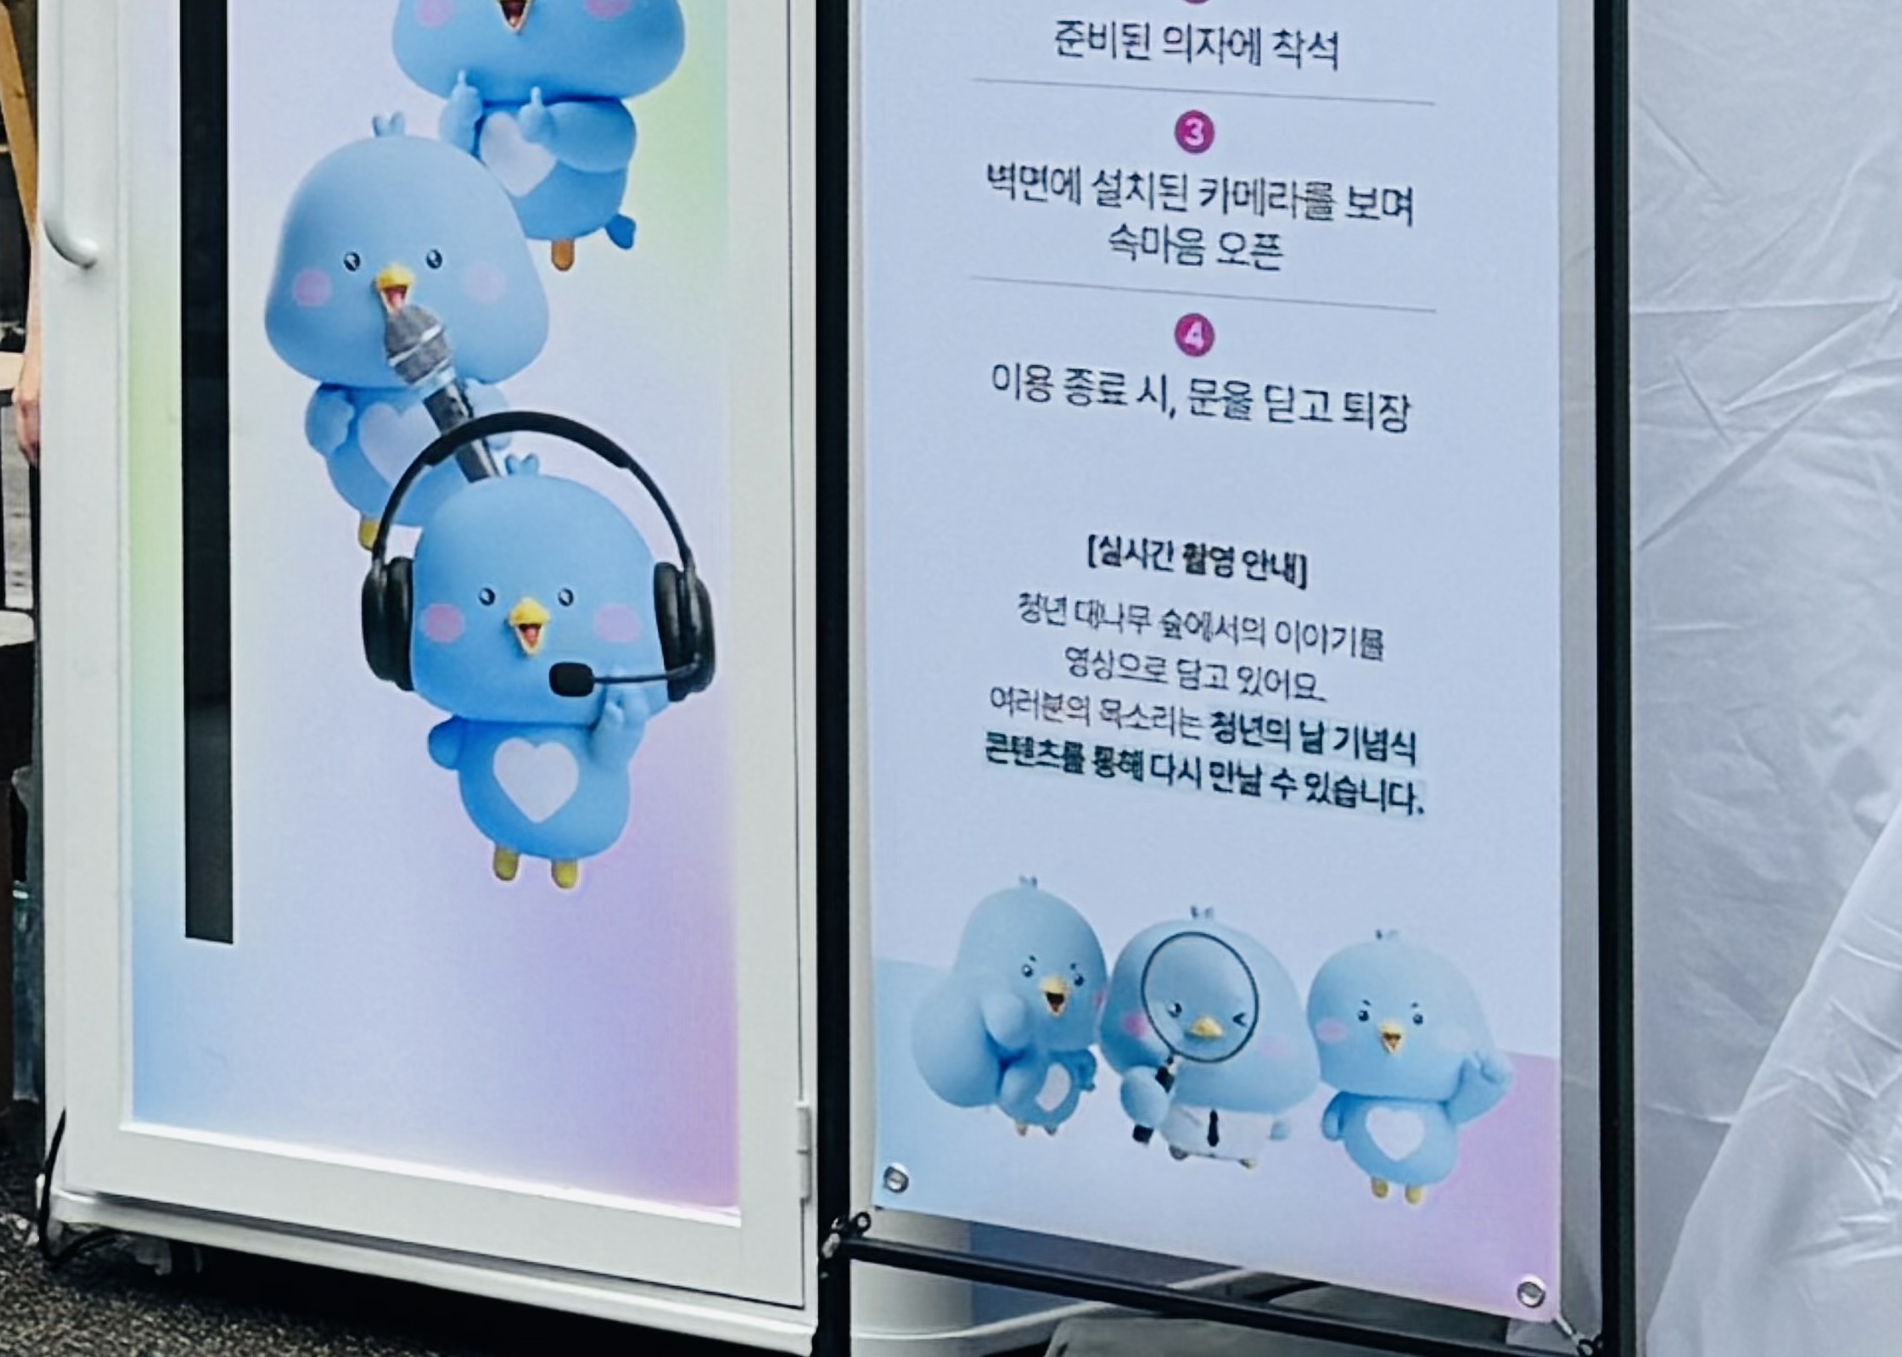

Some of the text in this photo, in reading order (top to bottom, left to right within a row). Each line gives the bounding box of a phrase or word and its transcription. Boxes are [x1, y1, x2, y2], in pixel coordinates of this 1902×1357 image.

[1055, 20, 1340, 71] 준비된 의자에 착석
[986, 163, 1414, 227] 벽면에 설치된 카메라를 보며
[1109, 223, 1283, 271] 속마음 오픈
[992, 362, 1054, 403] 이용
[1063, 367, 1129, 409] 종료
[1137, 373, 1177, 420] 시,
[1187, 377, 1254, 420] 문을
[1342, 393, 1411, 434] 퇴장
[1088, 533, 1175, 573] [실시간
[1243, 550, 1308, 590] 안내]
[1017, 591, 1385, 661] 청년 대나무 숲에서의 이야기를
[1064, 645, 1326, 703] 영상으로 담고 있어요.
[990, 684, 1417, 767] 여러분의 목소리는 청년의 날 기념식
[985, 731, 1426, 817] 콘텐츠를 통해 다시 만날 수 있습니다.
